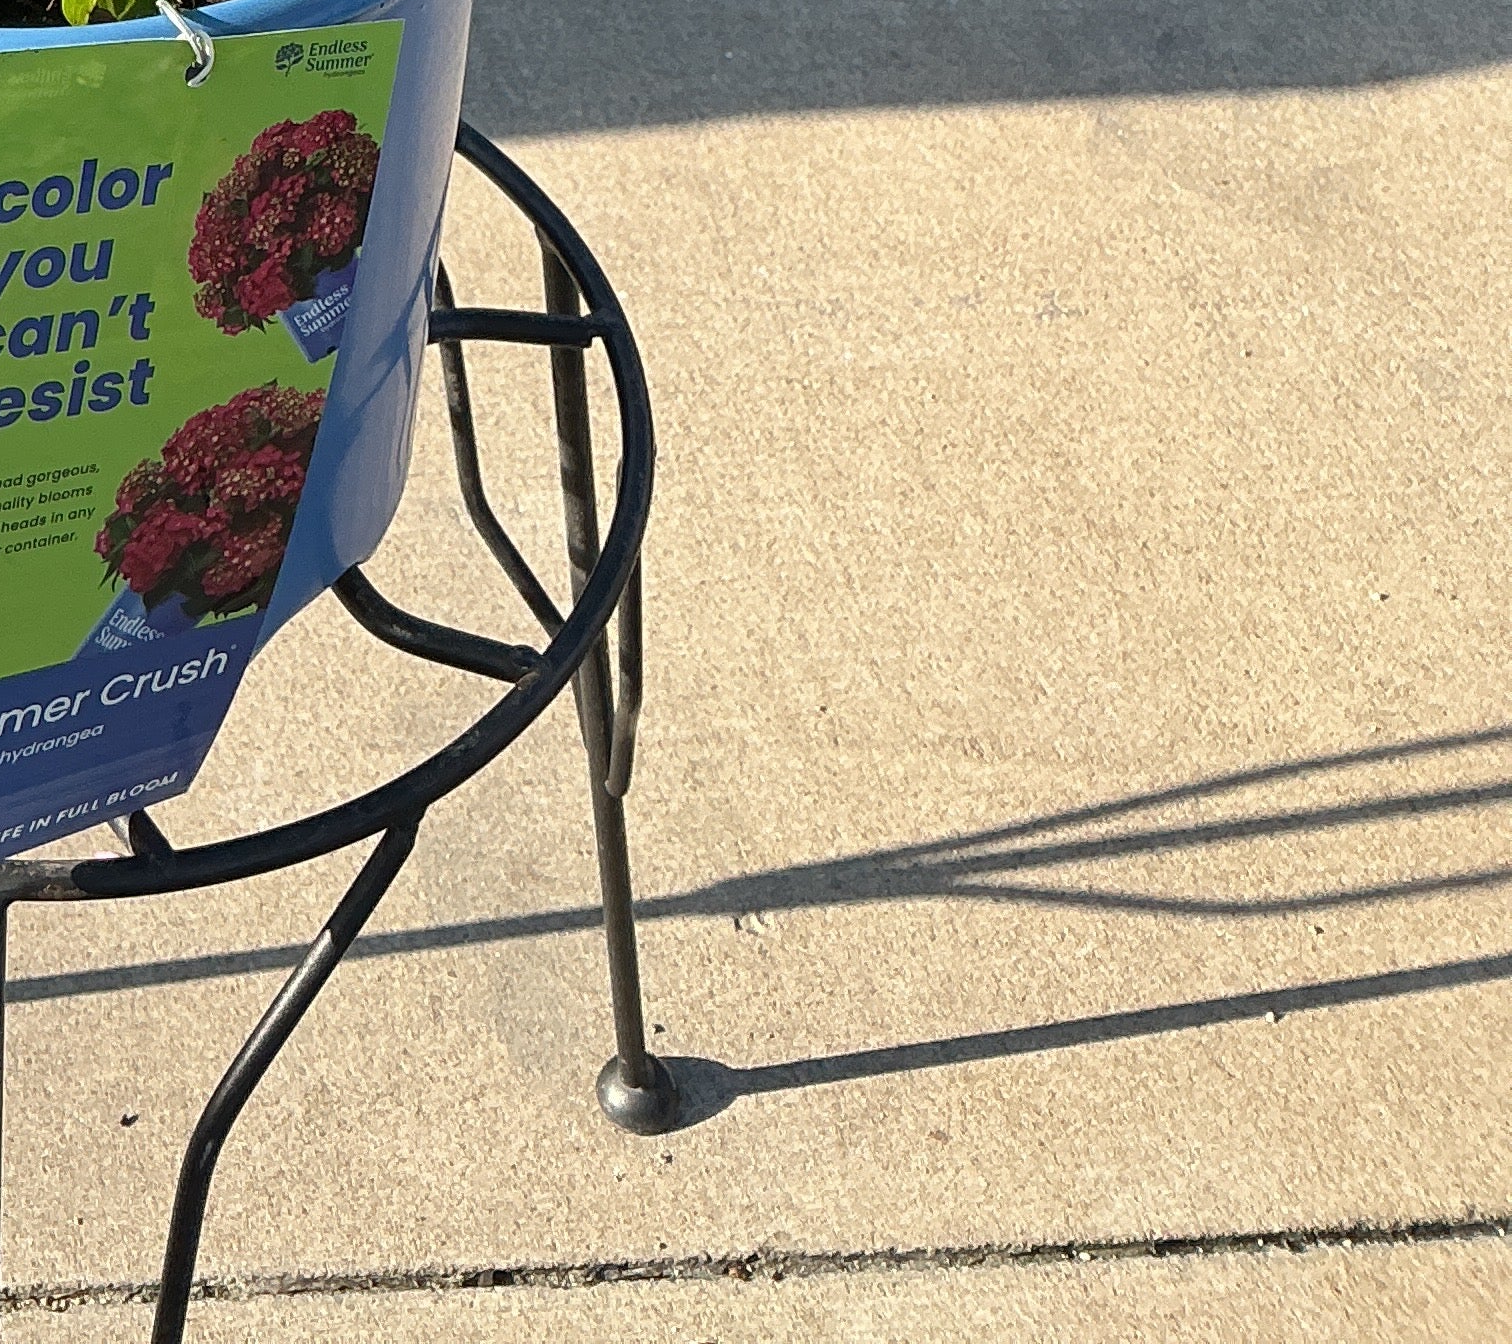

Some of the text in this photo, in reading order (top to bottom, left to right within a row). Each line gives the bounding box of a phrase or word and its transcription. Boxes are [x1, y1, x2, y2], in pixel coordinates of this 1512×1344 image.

[308, 39, 369, 56] Endless
[305, 53, 373, 72] Summer
[293, 284, 349, 327] Endless
[26, 463, 100, 488] gorgeous,
[38, 485, 93, 505] blooms
[0, 515, 47, 534] heads
[50, 511, 64, 524] in
[68, 506, 96, 521] any
[4, 531, 78, 555] container.
[99, 645, 230, 707] Crush
[0, 723, 105, 765] hydrangea
[29, 814, 52, 833] IN
[56, 798, 100, 824] FULL
[105, 771, 180, 807] BLOOM
